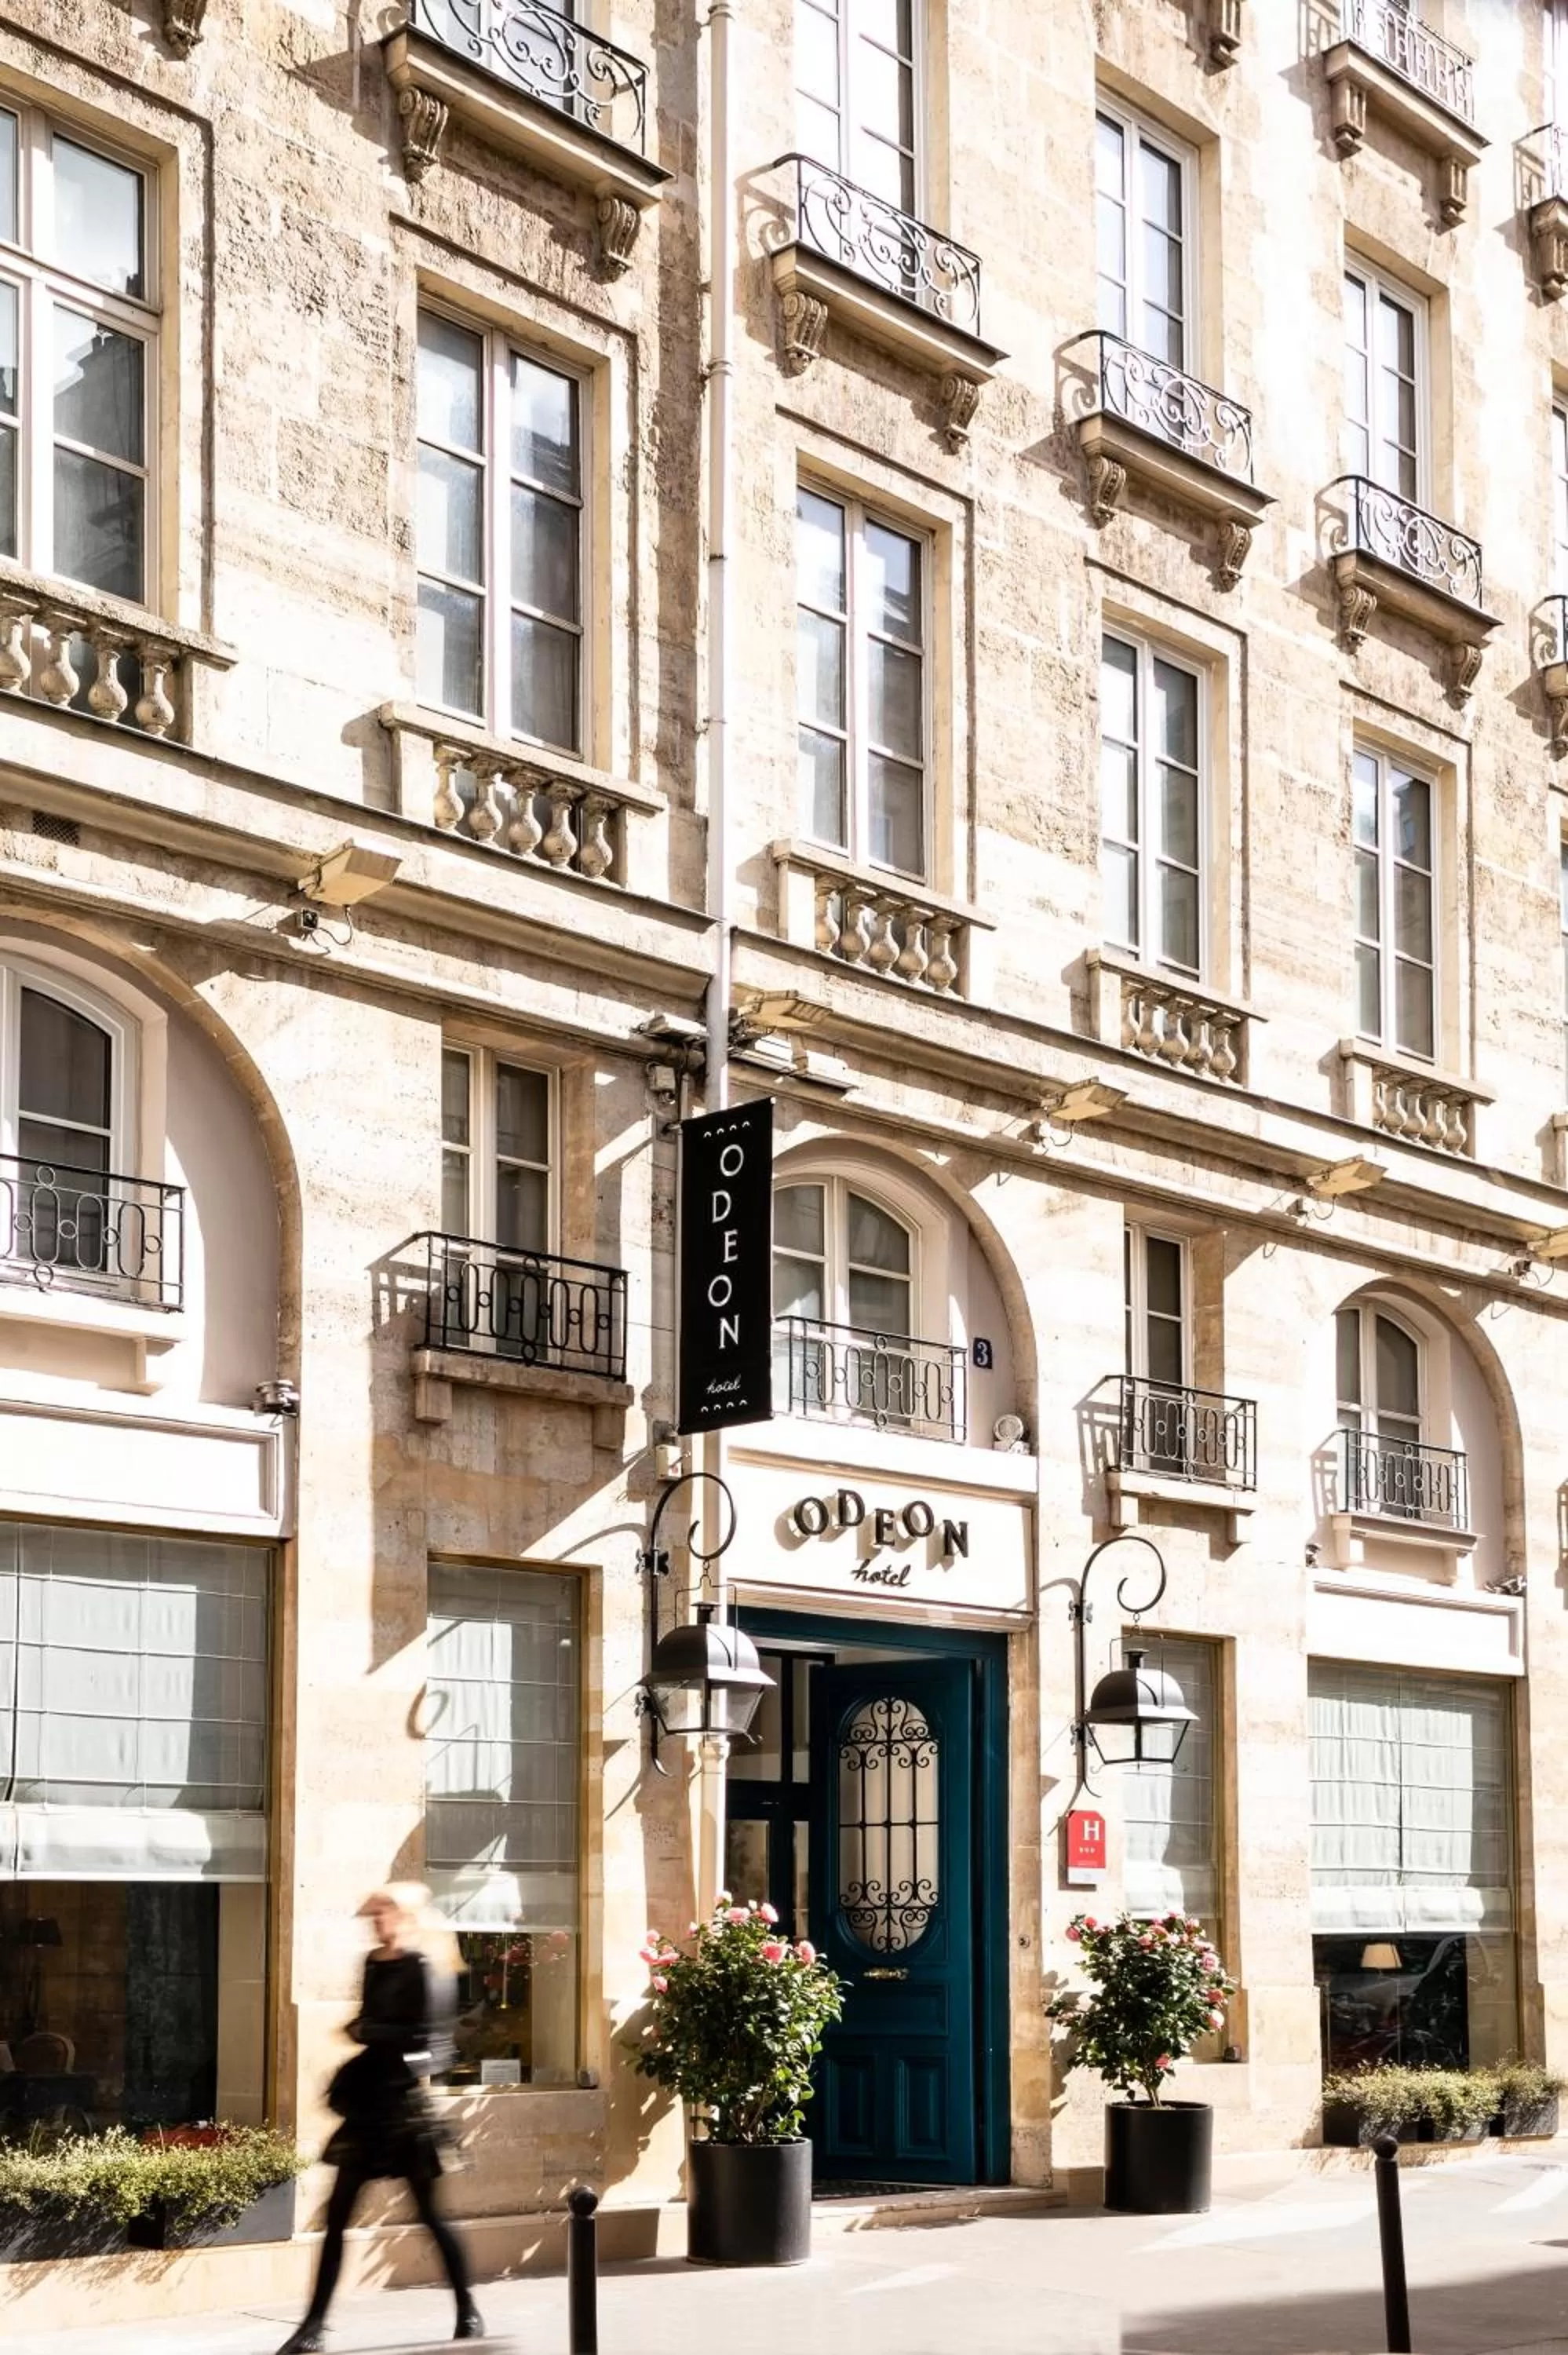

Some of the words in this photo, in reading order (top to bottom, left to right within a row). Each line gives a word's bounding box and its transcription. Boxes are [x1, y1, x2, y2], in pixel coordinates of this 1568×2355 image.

[707, 1143, 745, 1349] ODEON
[976, 1342, 988, 1366] 3
[706, 1374, 741, 1394] hotel
[794, 1488, 968, 1557] ODEON
[850, 1558, 911, 1587] hotel
[1082, 1820, 1099, 1841] H
